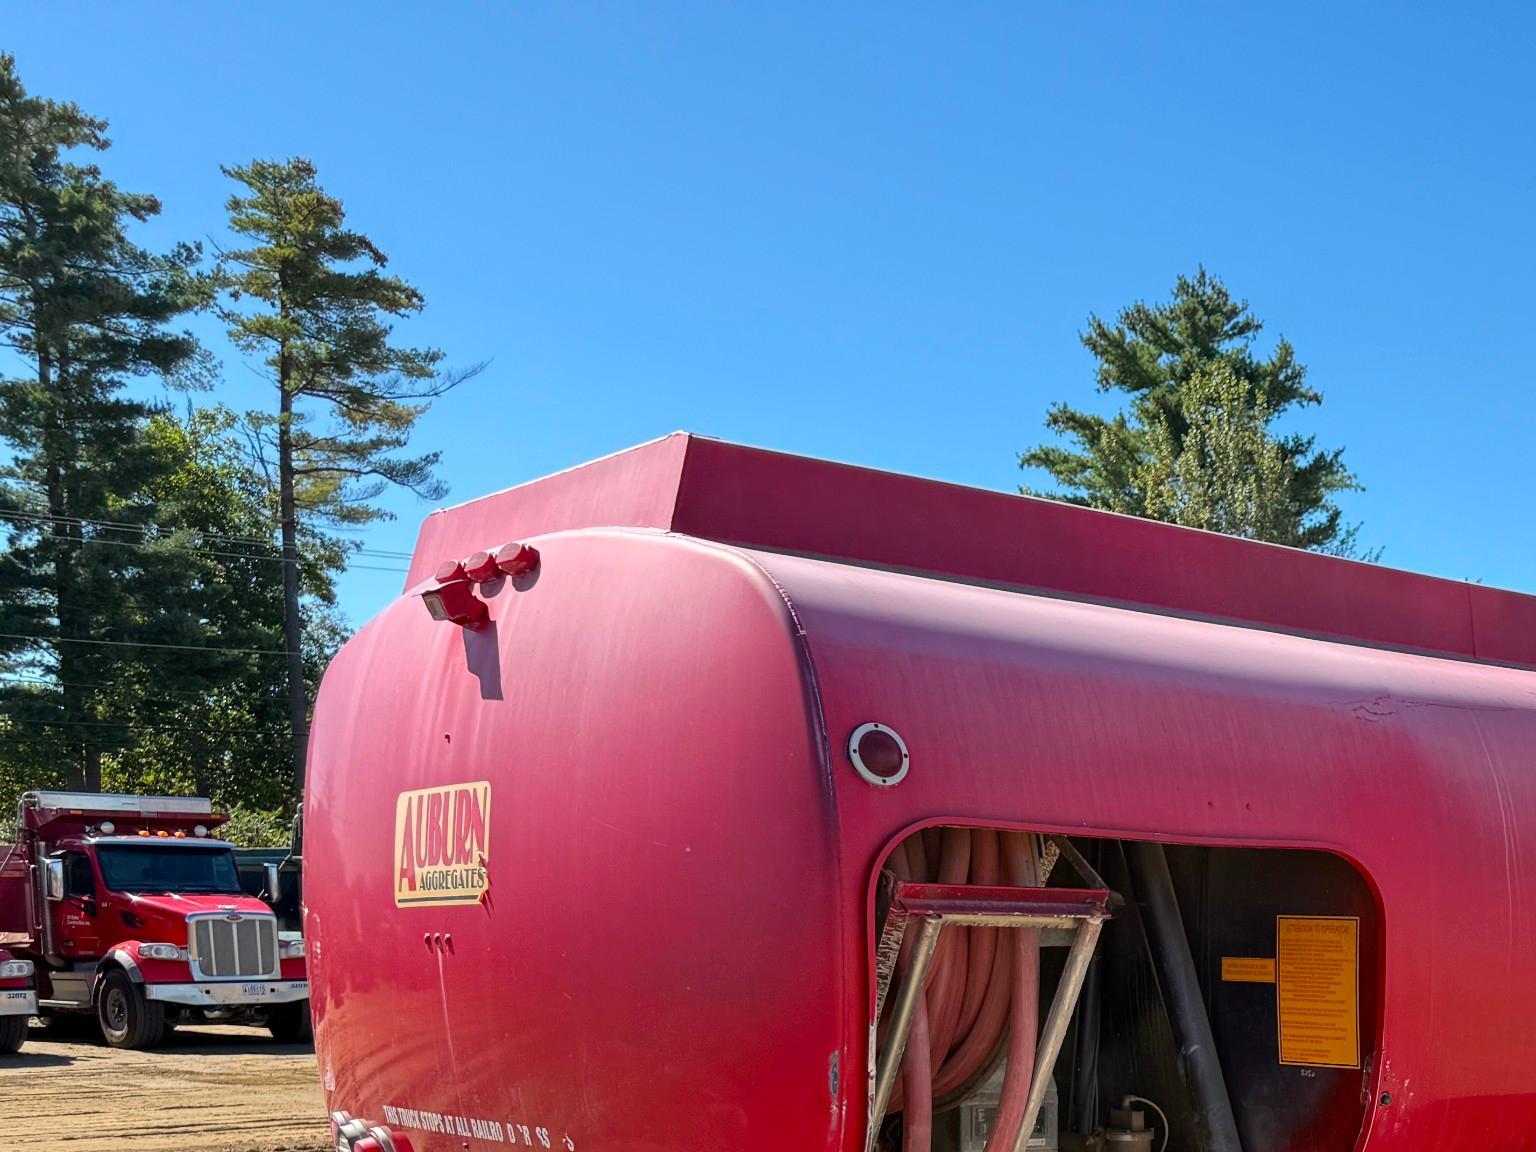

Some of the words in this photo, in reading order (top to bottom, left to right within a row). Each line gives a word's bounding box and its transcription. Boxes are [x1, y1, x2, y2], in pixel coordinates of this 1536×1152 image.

[399, 786, 488, 892] AUBURN
[419, 867, 485, 891] AGGREGATES
[383, 1105, 399, 1125] THIS
[397, 1107, 421, 1129] TRUCK
[420, 1111, 445, 1134] STOPS
[444, 1115, 455, 1134] AT
[456, 1116, 472, 1137] ALL
